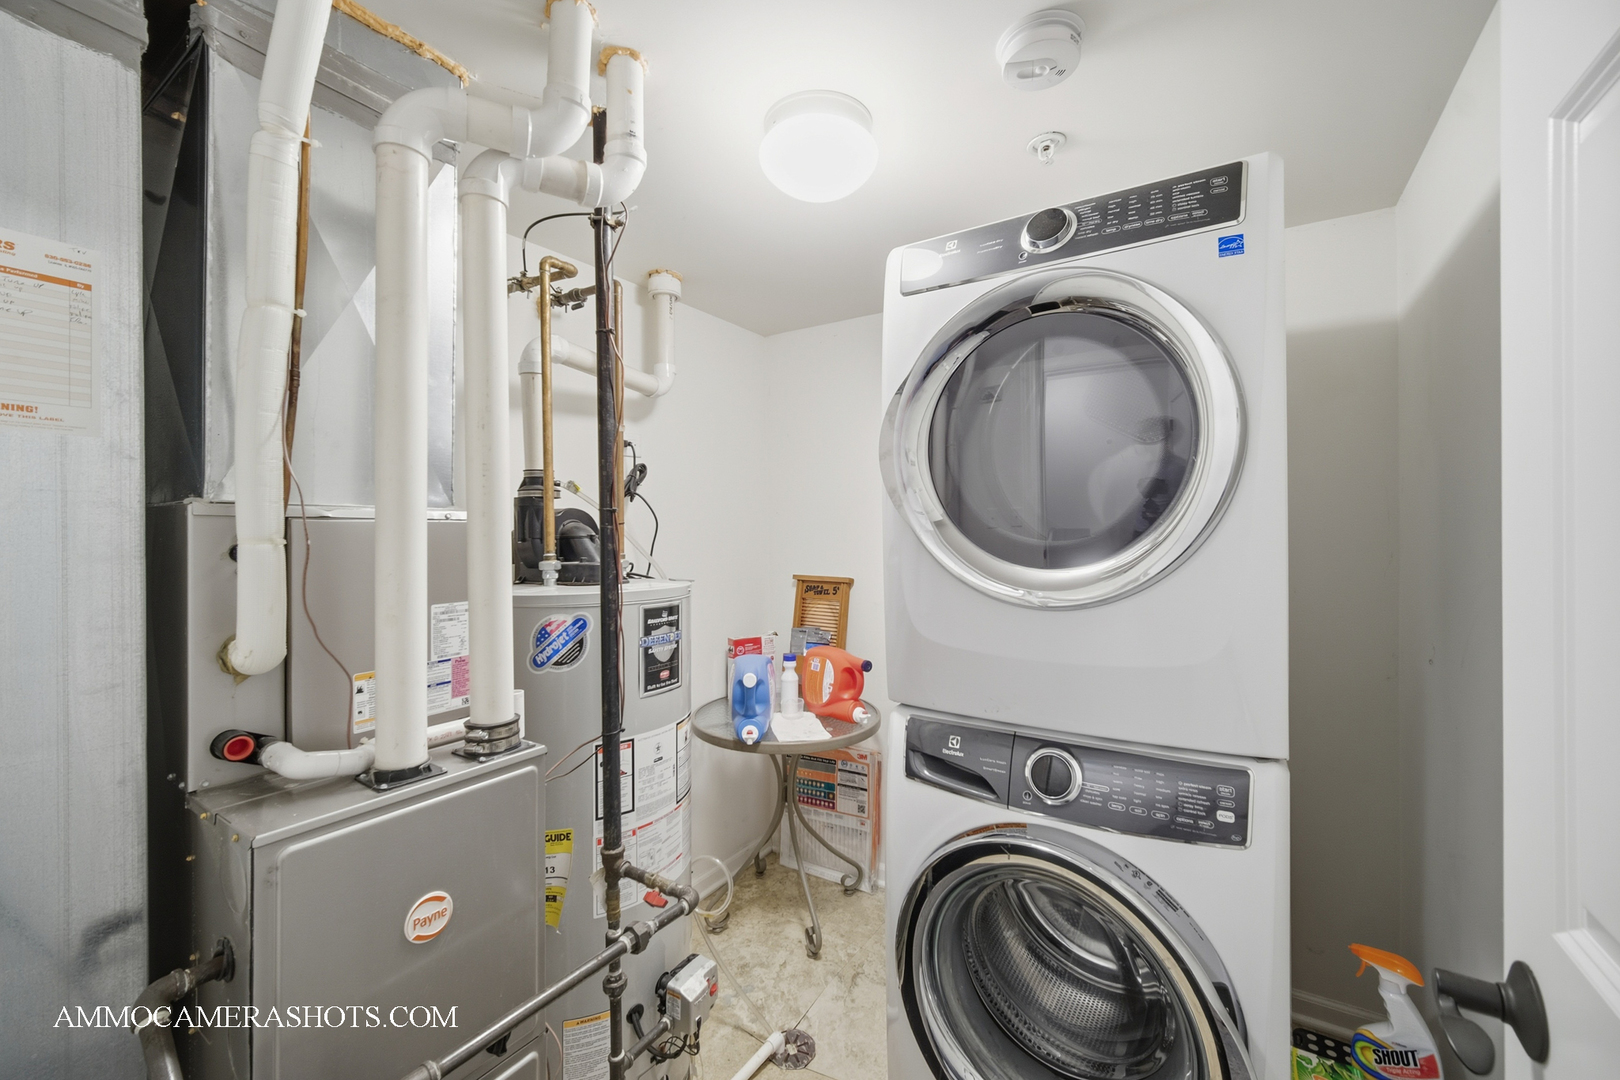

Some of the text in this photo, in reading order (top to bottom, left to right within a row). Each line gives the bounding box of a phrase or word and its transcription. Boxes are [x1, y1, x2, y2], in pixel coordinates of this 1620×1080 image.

[535, 631, 570, 664] Hydrojet
[413, 907, 447, 931] Payne
[1372, 1048, 1418, 1067] SHOUT
